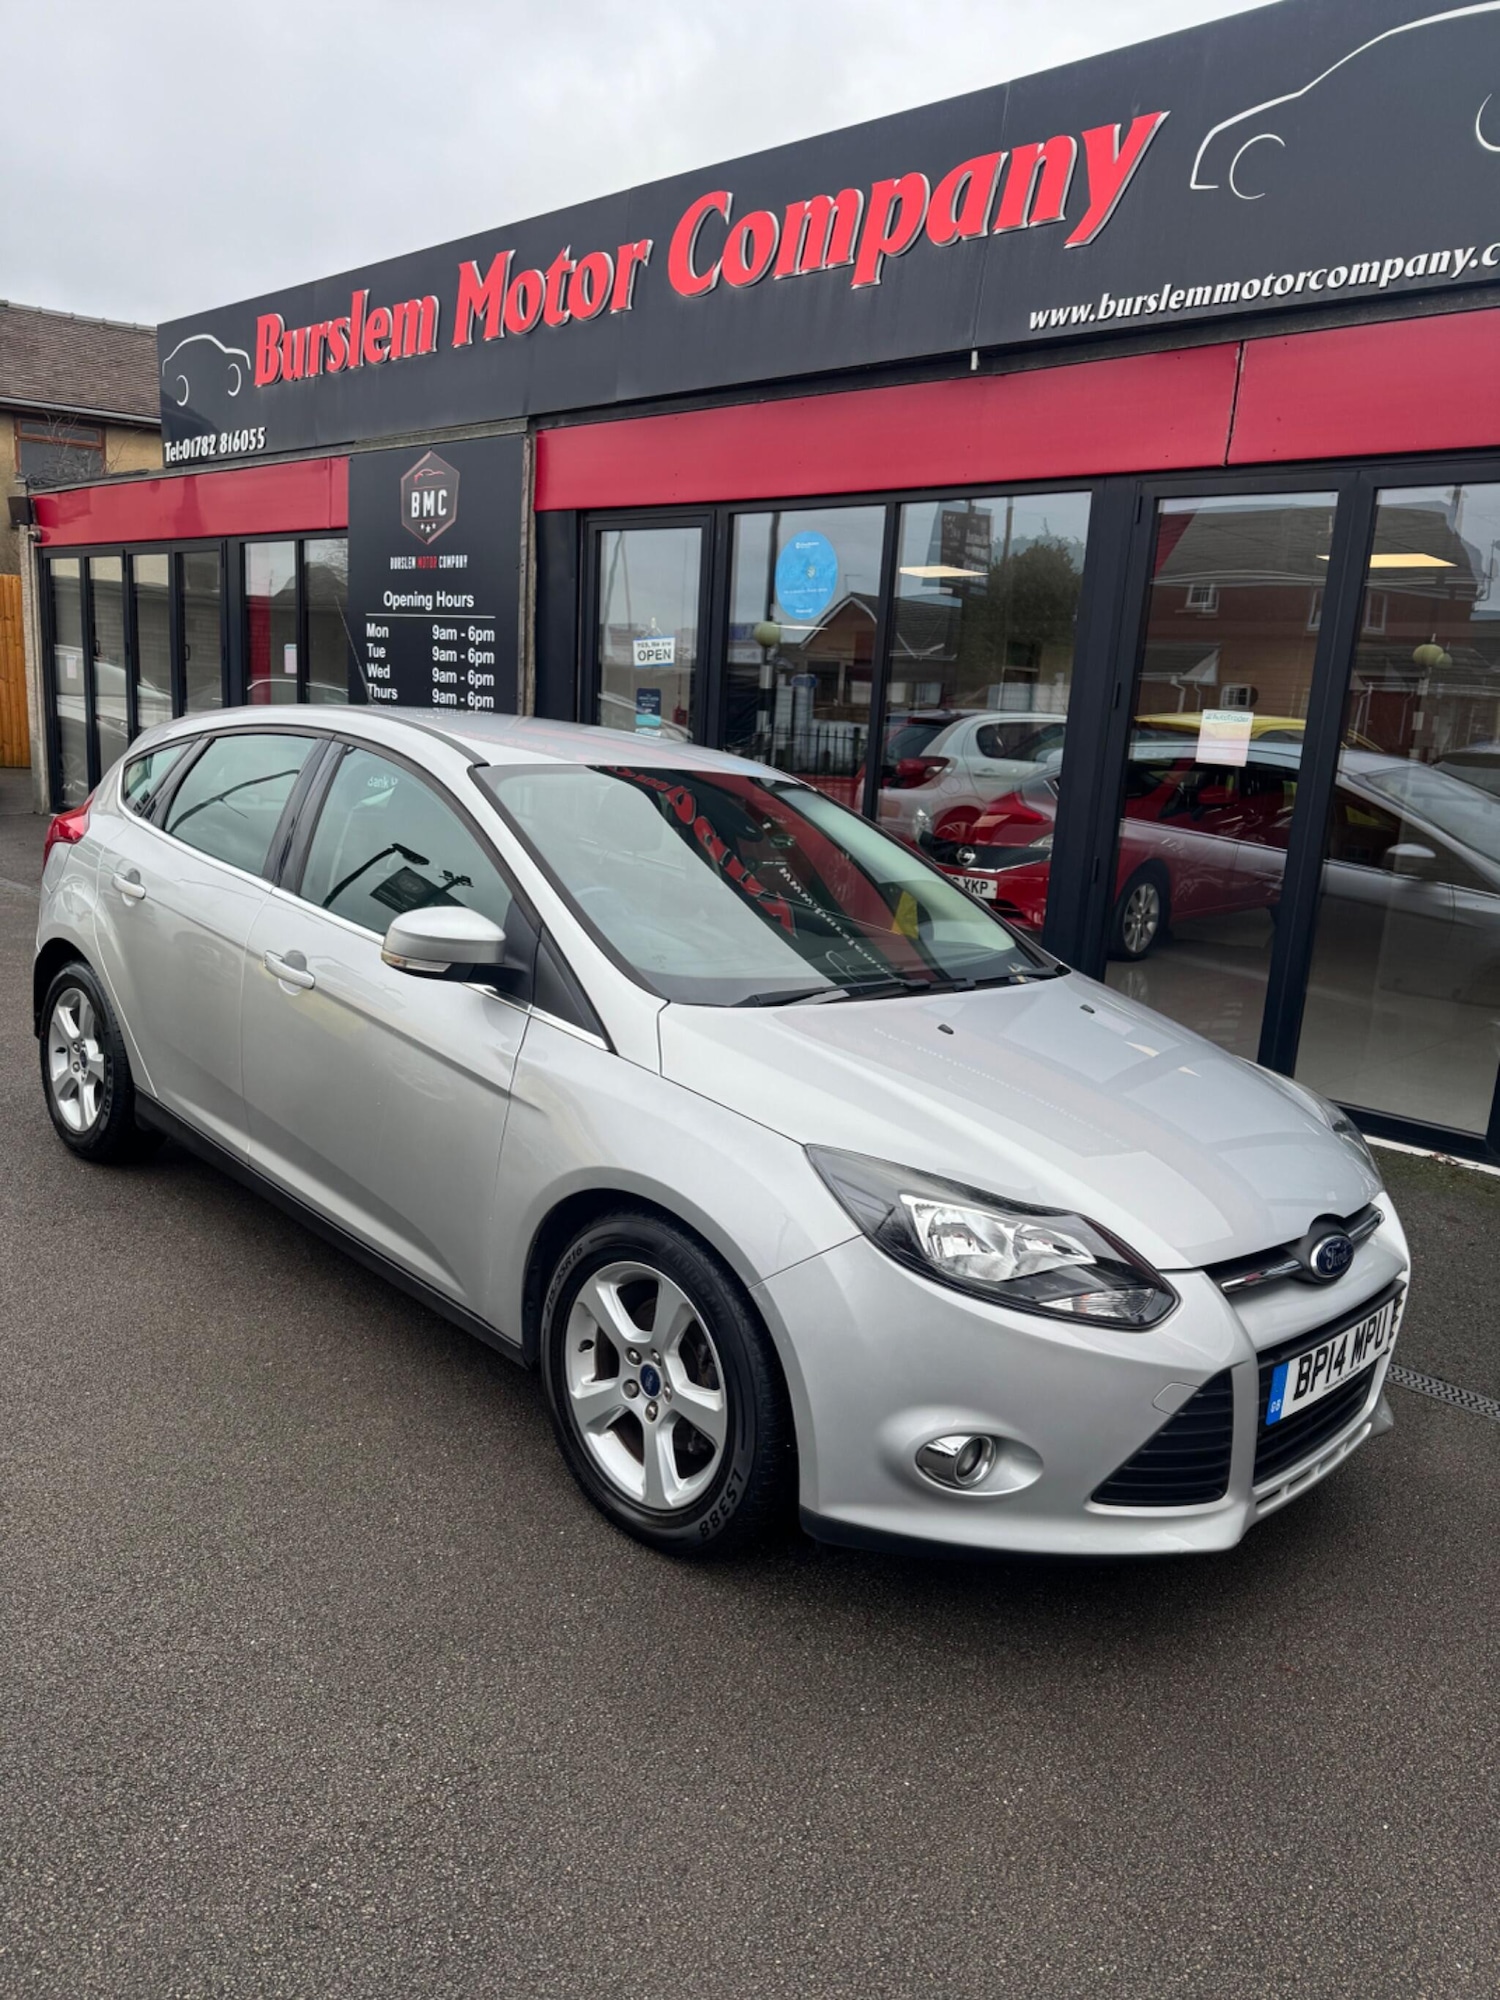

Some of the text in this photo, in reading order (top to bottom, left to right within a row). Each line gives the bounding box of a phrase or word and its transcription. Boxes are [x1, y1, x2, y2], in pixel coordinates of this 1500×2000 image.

[254, 111, 1171, 387] Burslem Motor Company
[164, 427, 267, 462] Tel:01782 816055
[411, 489, 447, 518] BMC
[438, 554, 468, 568] COMPANY
[383, 590, 475, 611] Opening Hours
[366, 623, 389, 639] Mon
[432, 624, 457, 641] 9am
[468, 626, 495, 645] 6pm
[367, 643, 386, 658] Tue
[432, 646, 457, 662] 9am
[468, 647, 495, 666] 6pm
[637, 648, 671, 661] OPEN
[367, 663, 390, 679] Wed
[432, 667, 457, 684] 9am
[468, 668, 495, 688] 6pm
[367, 683, 398, 700] Thurs
[432, 688, 457, 705] 9am
[468, 690, 495, 710] 6pm
[963, 877, 988, 895] XKP
[1325, 1241, 1350, 1270] Ford
[1293, 1306, 1389, 1400] BP14 MPU
[699, 1467, 743, 1538] LS388
